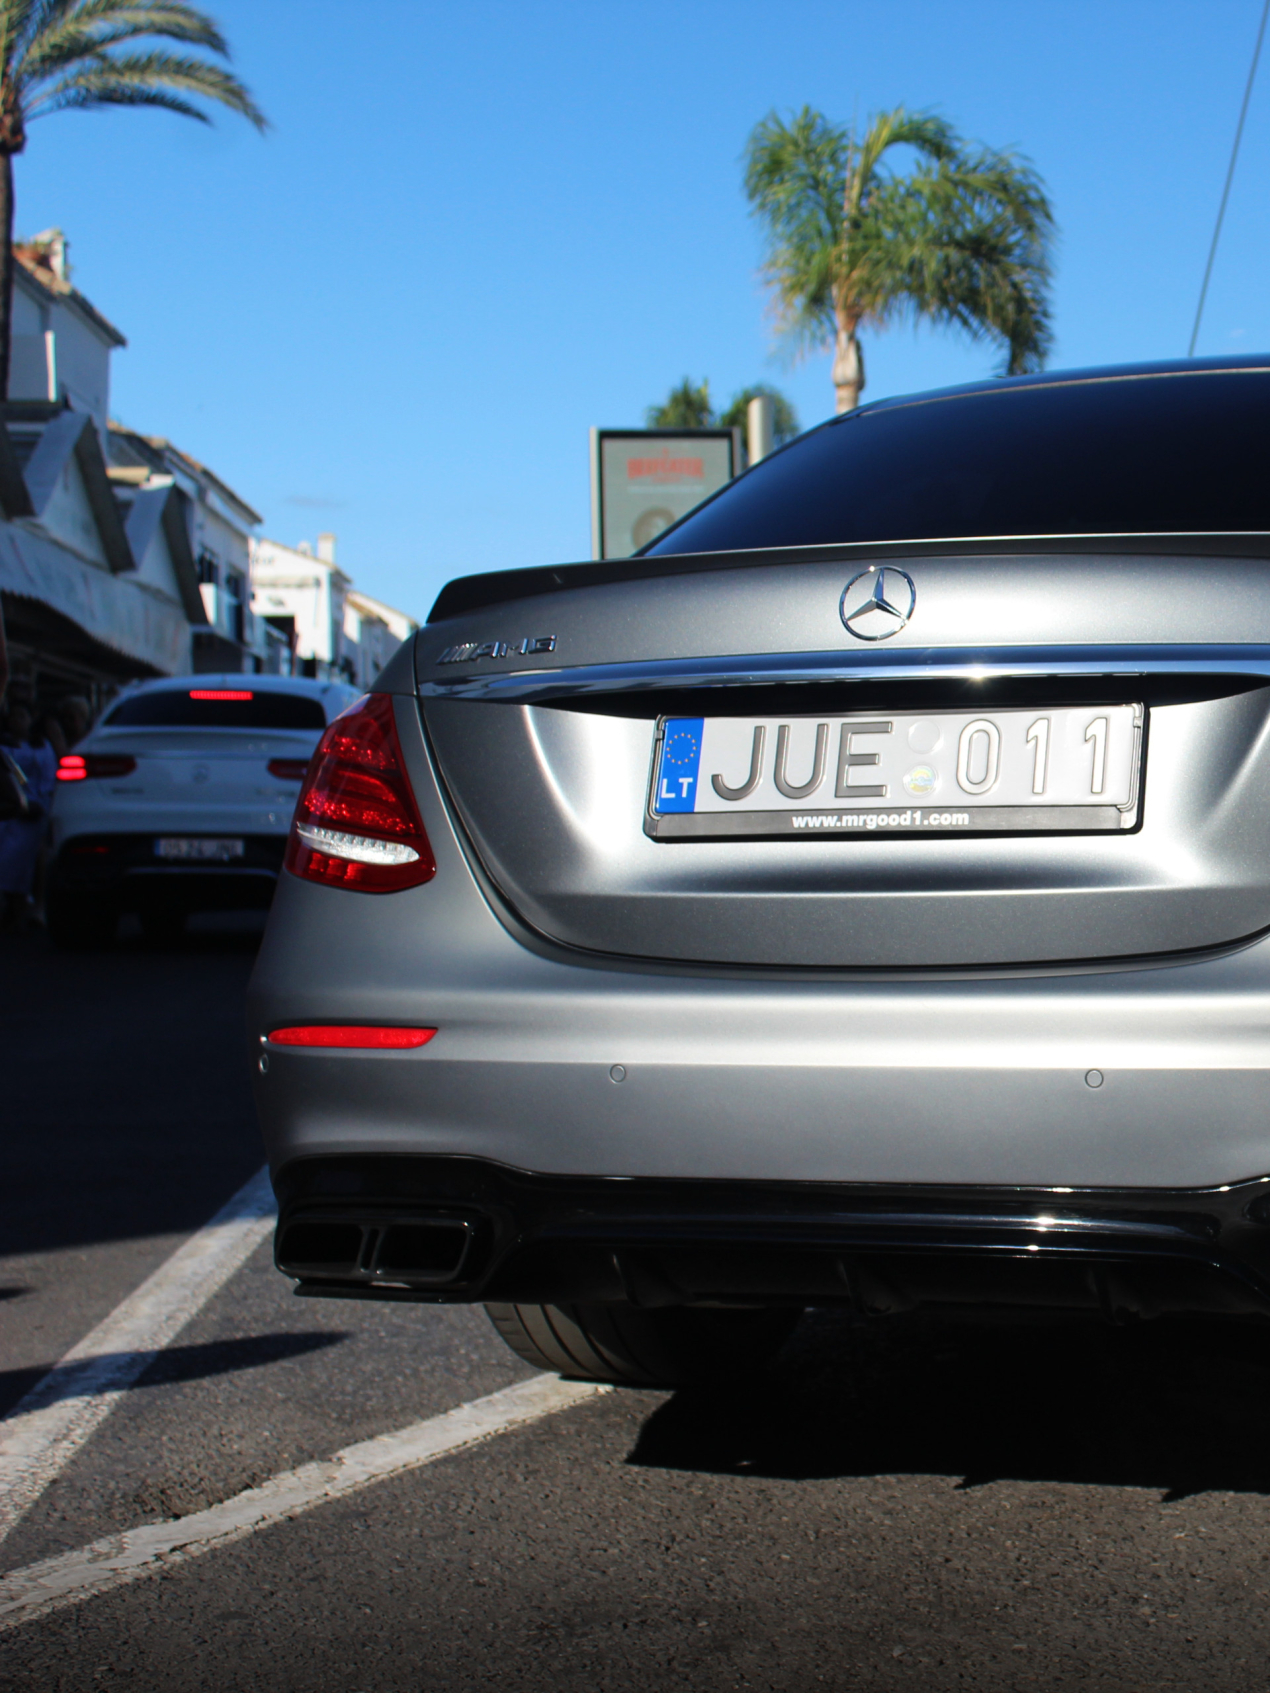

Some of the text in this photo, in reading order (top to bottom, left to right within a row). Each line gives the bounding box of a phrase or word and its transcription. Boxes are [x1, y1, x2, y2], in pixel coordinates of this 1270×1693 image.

[470, 634, 557, 661] AMG
[711, 717, 1108, 801] JUE 011
[660, 777, 693, 799] LT
[792, 810, 970, 829] www.mrgood1.com
